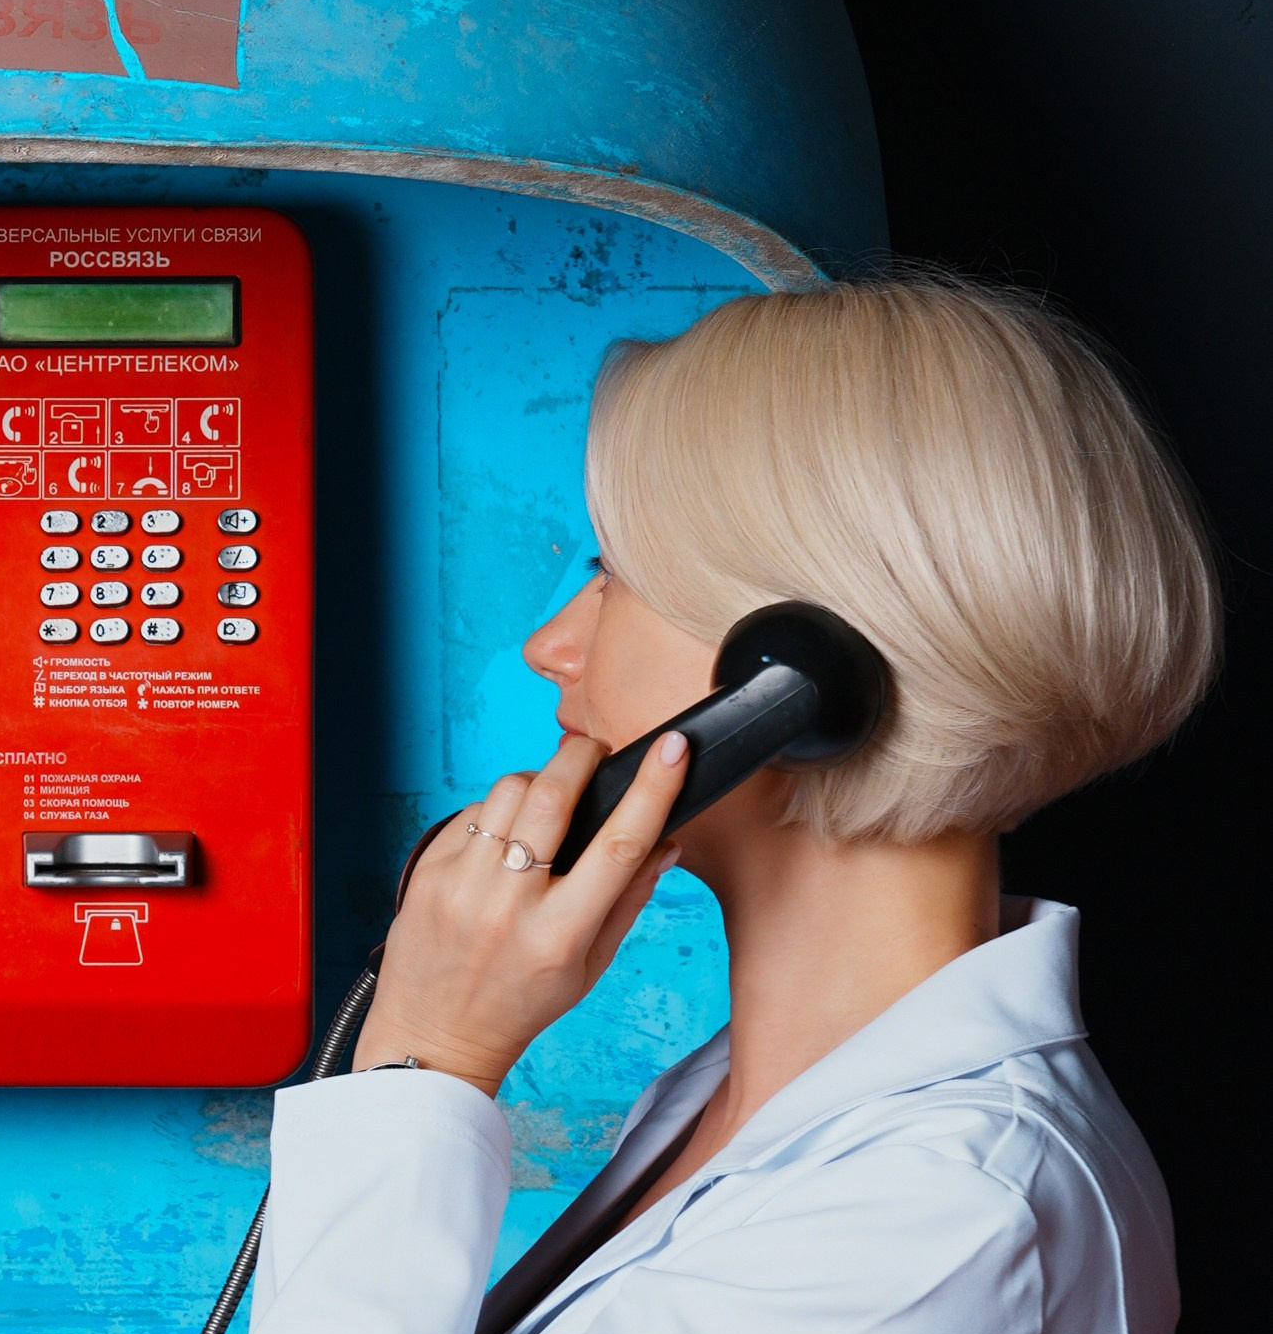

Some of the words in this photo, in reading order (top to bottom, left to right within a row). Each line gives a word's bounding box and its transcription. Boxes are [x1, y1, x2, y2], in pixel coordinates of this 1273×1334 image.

[126, 228, 196, 243] УСЛУГИ
[201, 227, 262, 243] СВЯЗИ
[49, 251, 171, 268] РОССВЯЗЬ
[35, 355, 239, 376] «ЦЕНТРТЕЛЕКОМ»
[48, 432, 58, 444] 2
[114, 432, 124, 444] 3
[181, 432, 191, 444] 4
[48, 482, 58, 495] 6
[116, 482, 125, 495] 7
[181, 482, 191, 495] 8
[46, 515, 52, 528] 1
[96, 515, 106, 528] 2
[147, 515, 156, 528] 3
[46, 550, 56, 564] 4
[96, 550, 106, 564] 5
[147, 550, 157, 563] 6
[46, 587, 55, 600] 7
[96, 587, 105, 600] 8
[146, 587, 156, 600] 9
[50, 658, 111, 667] ГРОМКОСТЬ
[50, 672, 97, 681] ПЕРЕХОД
[100, 672, 107, 680] В
[109, 671, 172, 680] ЧАСТОТНЫЙ
[175, 672, 212, 680] РЕЖИМ
[49, 686, 87, 694] ВЫБОР
[90, 686, 125, 694] ЯЗЫКА
[152, 686, 195, 695] НАЖАТЬ
[198, 686, 218, 694] ПРИ
[221, 686, 260, 695] ОТВЕТЕ
[49, 699, 90, 708] КНОПКА
[153, 700, 195, 708] ПОВТОР
[197, 700, 240, 709] НОМЕРА
[23, 775, 35, 783] 01
[40, 774, 98, 783] ПОЖАРНАЯ
[100, 774, 141, 783] ОХРАНА
[23, 786, 35, 795] 02
[40, 786, 90, 795] МИЛИЦИЯ
[23, 799, 35, 807] 03
[40, 799, 80, 807] СКОРАЯ
[82, 799, 130, 808] ПОМОЩЬ
[23, 811, 35, 820] 04
[40, 811, 82, 820] СЛУЖБА
[84, 811, 110, 820] ГАЗА
